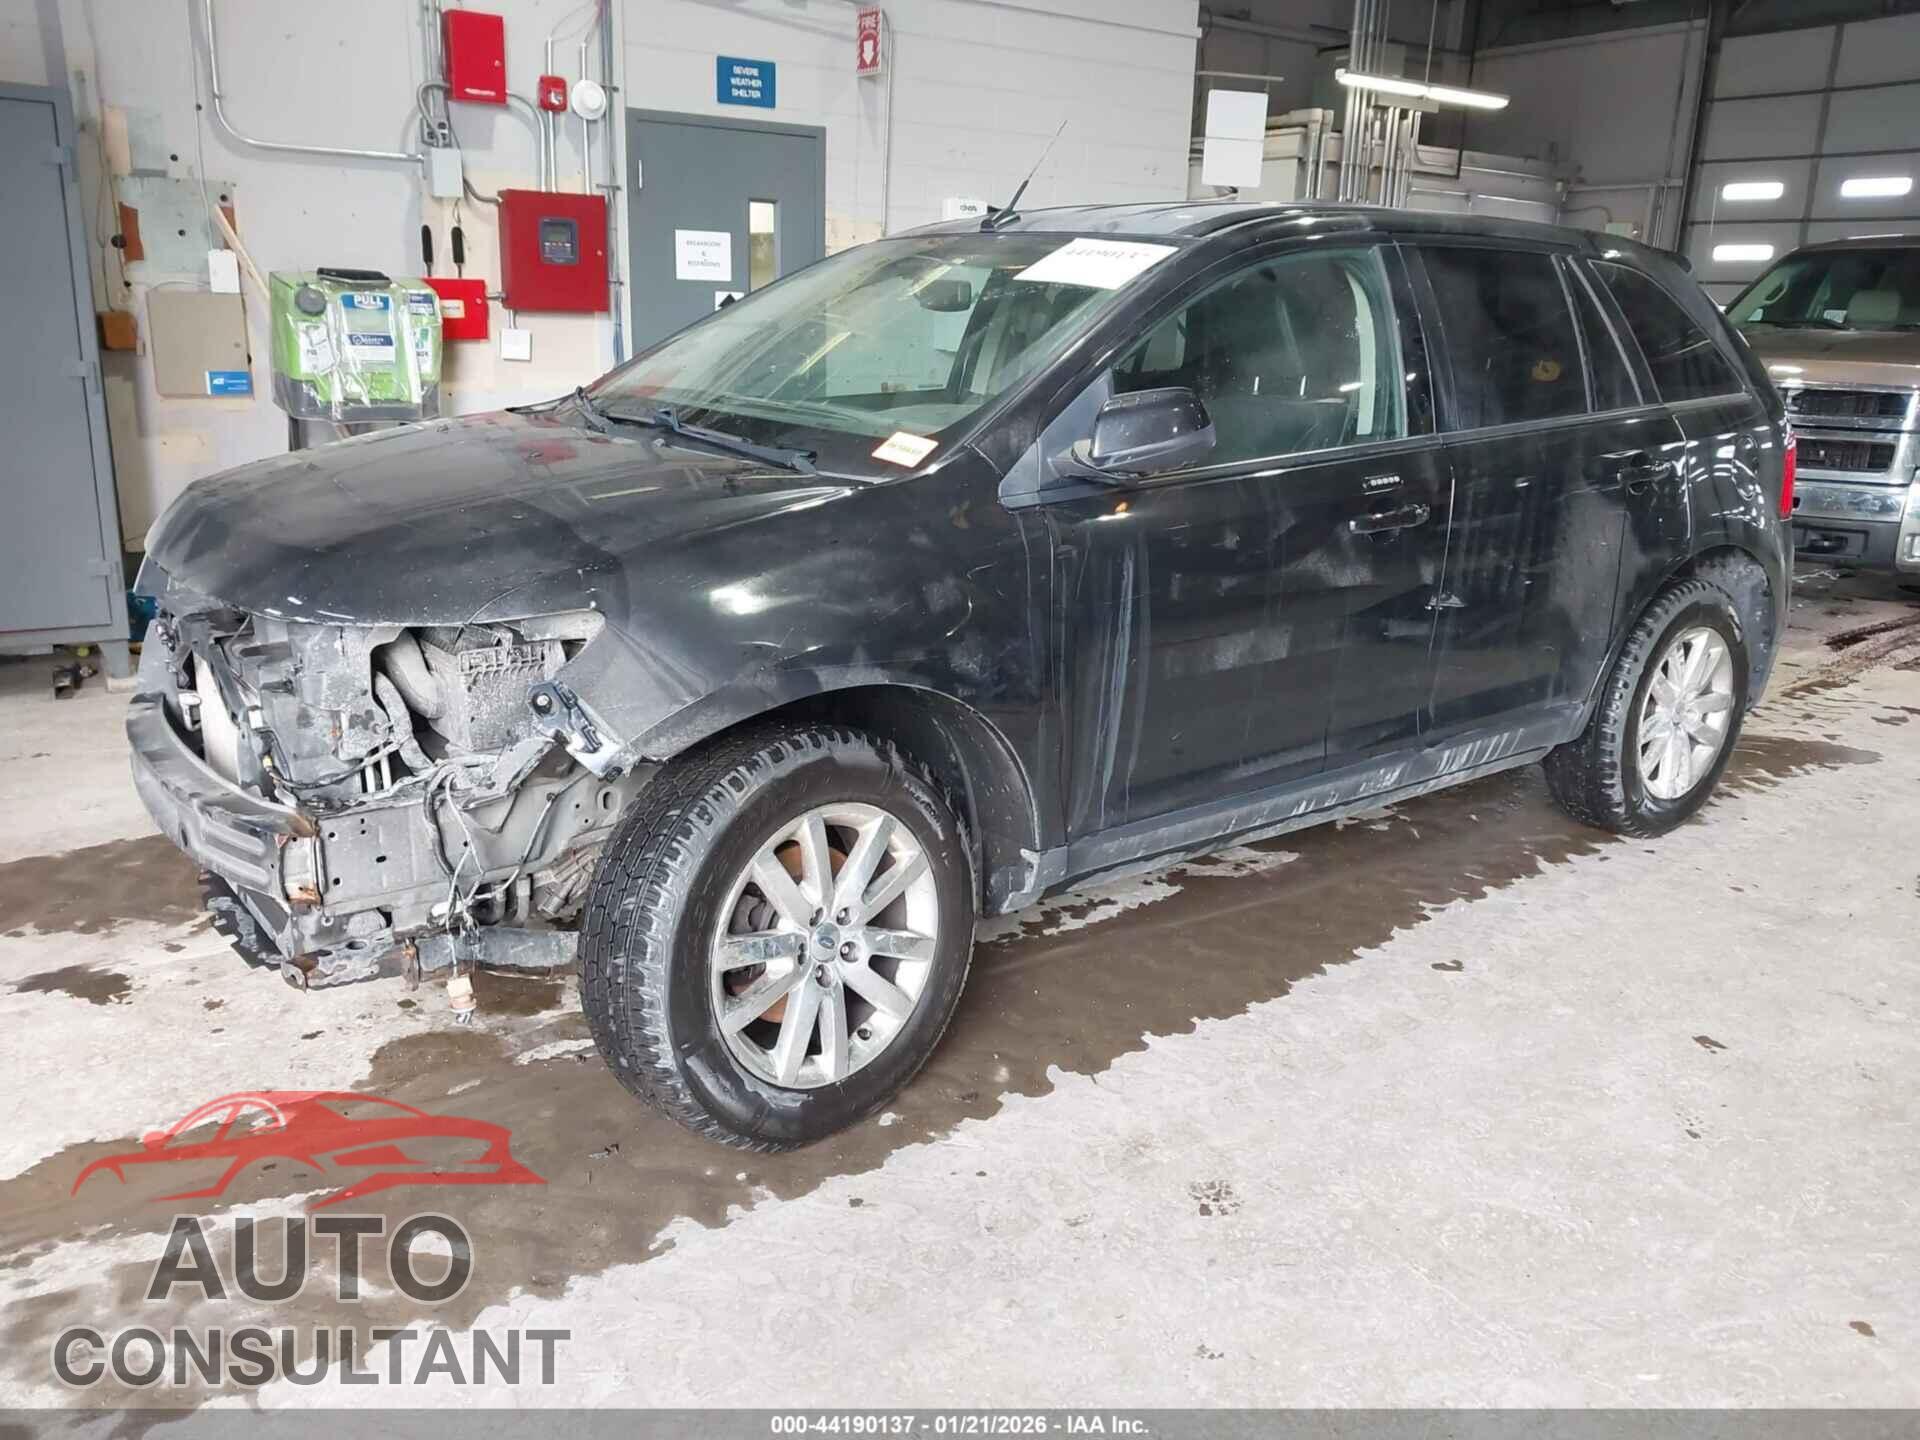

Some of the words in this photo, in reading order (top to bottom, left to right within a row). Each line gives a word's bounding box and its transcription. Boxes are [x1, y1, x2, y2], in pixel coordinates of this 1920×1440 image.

[861, 14, 877, 29] FIRE
[732, 65, 759, 76] SEVERE
[730, 77, 762, 88] WEATHER
[731, 88, 761, 99] SHELTER
[353, 293, 384, 309] PULL
